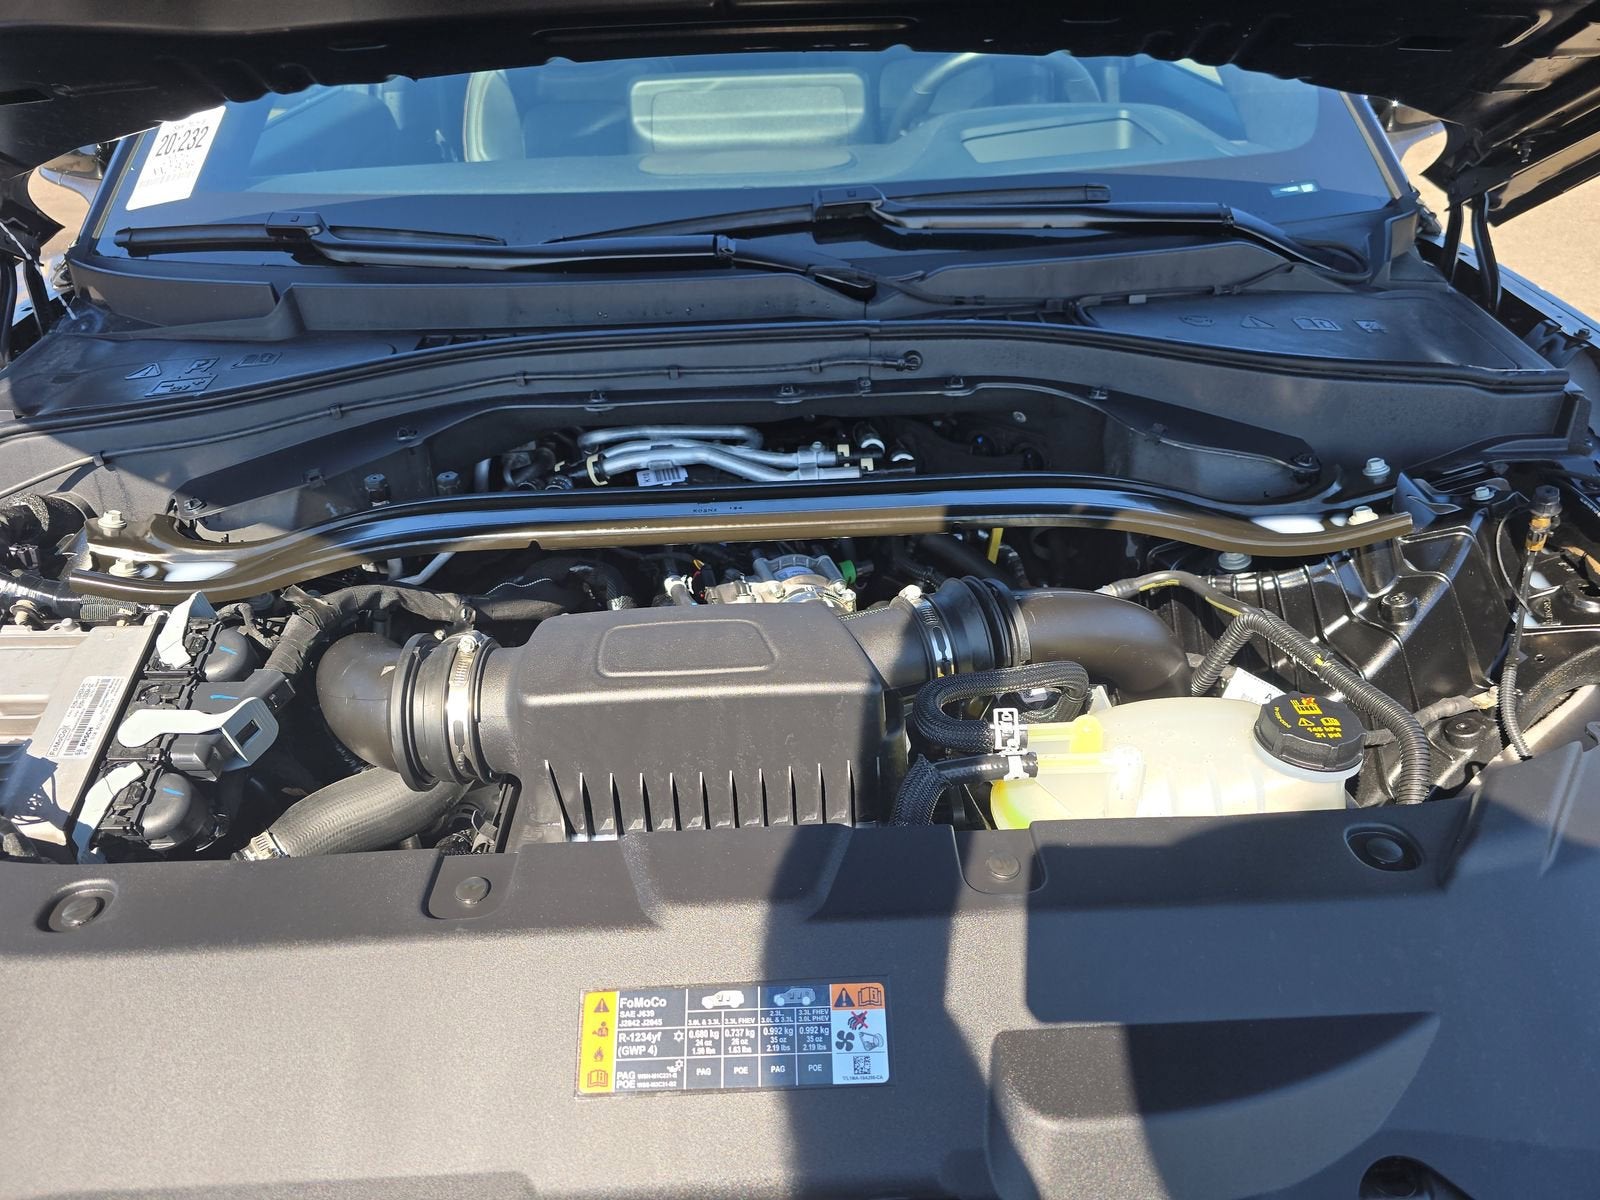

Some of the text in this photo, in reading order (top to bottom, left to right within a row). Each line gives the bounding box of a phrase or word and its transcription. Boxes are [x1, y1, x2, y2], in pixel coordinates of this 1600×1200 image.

[80, 726, 94, 747] BOSCH
[619, 996, 667, 1009] FoMoCo
[619, 1010, 655, 1018] SAE J639
[724, 1017, 738, 1025] 3.3L
[709, 1028, 720, 1040] kg
[724, 1027, 756, 1039] 0.737 kg
[762, 1026, 794, 1037] 0.992 kg
[799, 1025, 830, 1036] 0.992 kg
[618, 1031, 662, 1044] R-1234yf
[740, 1038, 750, 1046] oz
[770, 1036, 779, 1044] 35
[806, 1035, 815, 1043] 35
[617, 1044, 658, 1058] (GWP 4)
[741, 1045, 753, 1054] lbs
[766, 1044, 780, 1052] 2.19
[802, 1043, 816, 1051] 2.19
[696, 1067, 712, 1076] PAG
[733, 1066, 749, 1075] POE
[770, 1065, 786, 1073] PAG
[808, 1064, 822, 1072] POE
[616, 1071, 636, 1080] PAG
[616, 1079, 636, 1089] POE
